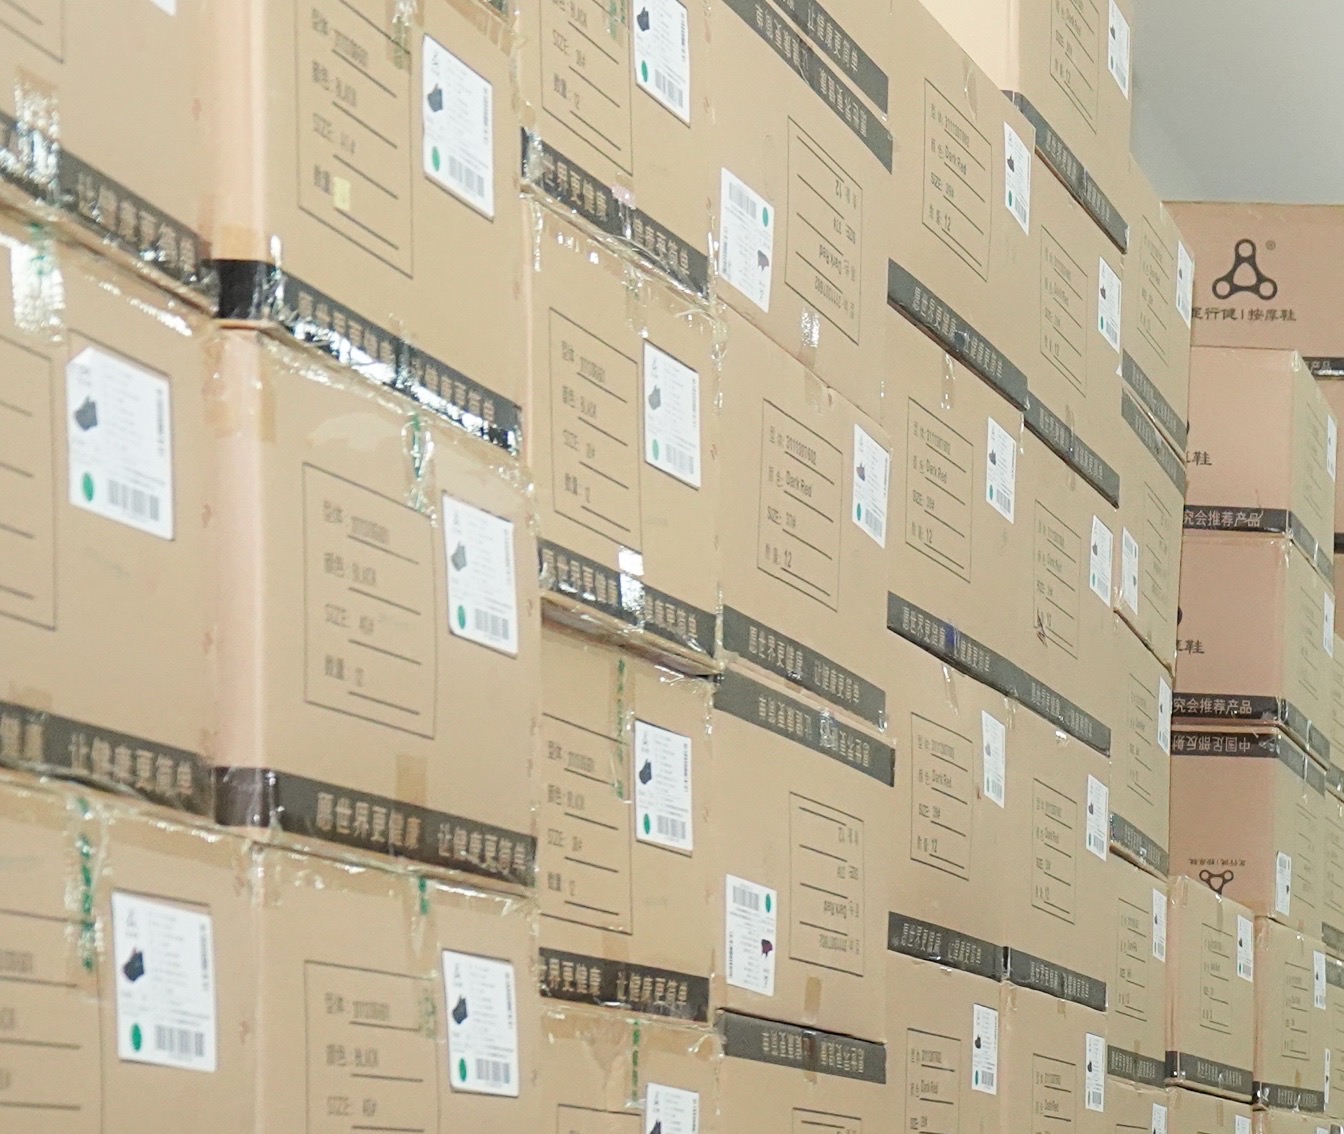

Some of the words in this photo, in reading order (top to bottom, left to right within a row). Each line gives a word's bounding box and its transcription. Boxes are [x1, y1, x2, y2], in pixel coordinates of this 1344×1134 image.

[1186, 450, 1212, 466] 鞋
[1183, 509, 1261, 527] 究会推荐产品
[1176, 640, 1205, 654] 鞋
[1173, 698, 1252, 715] 究会推荐产品
